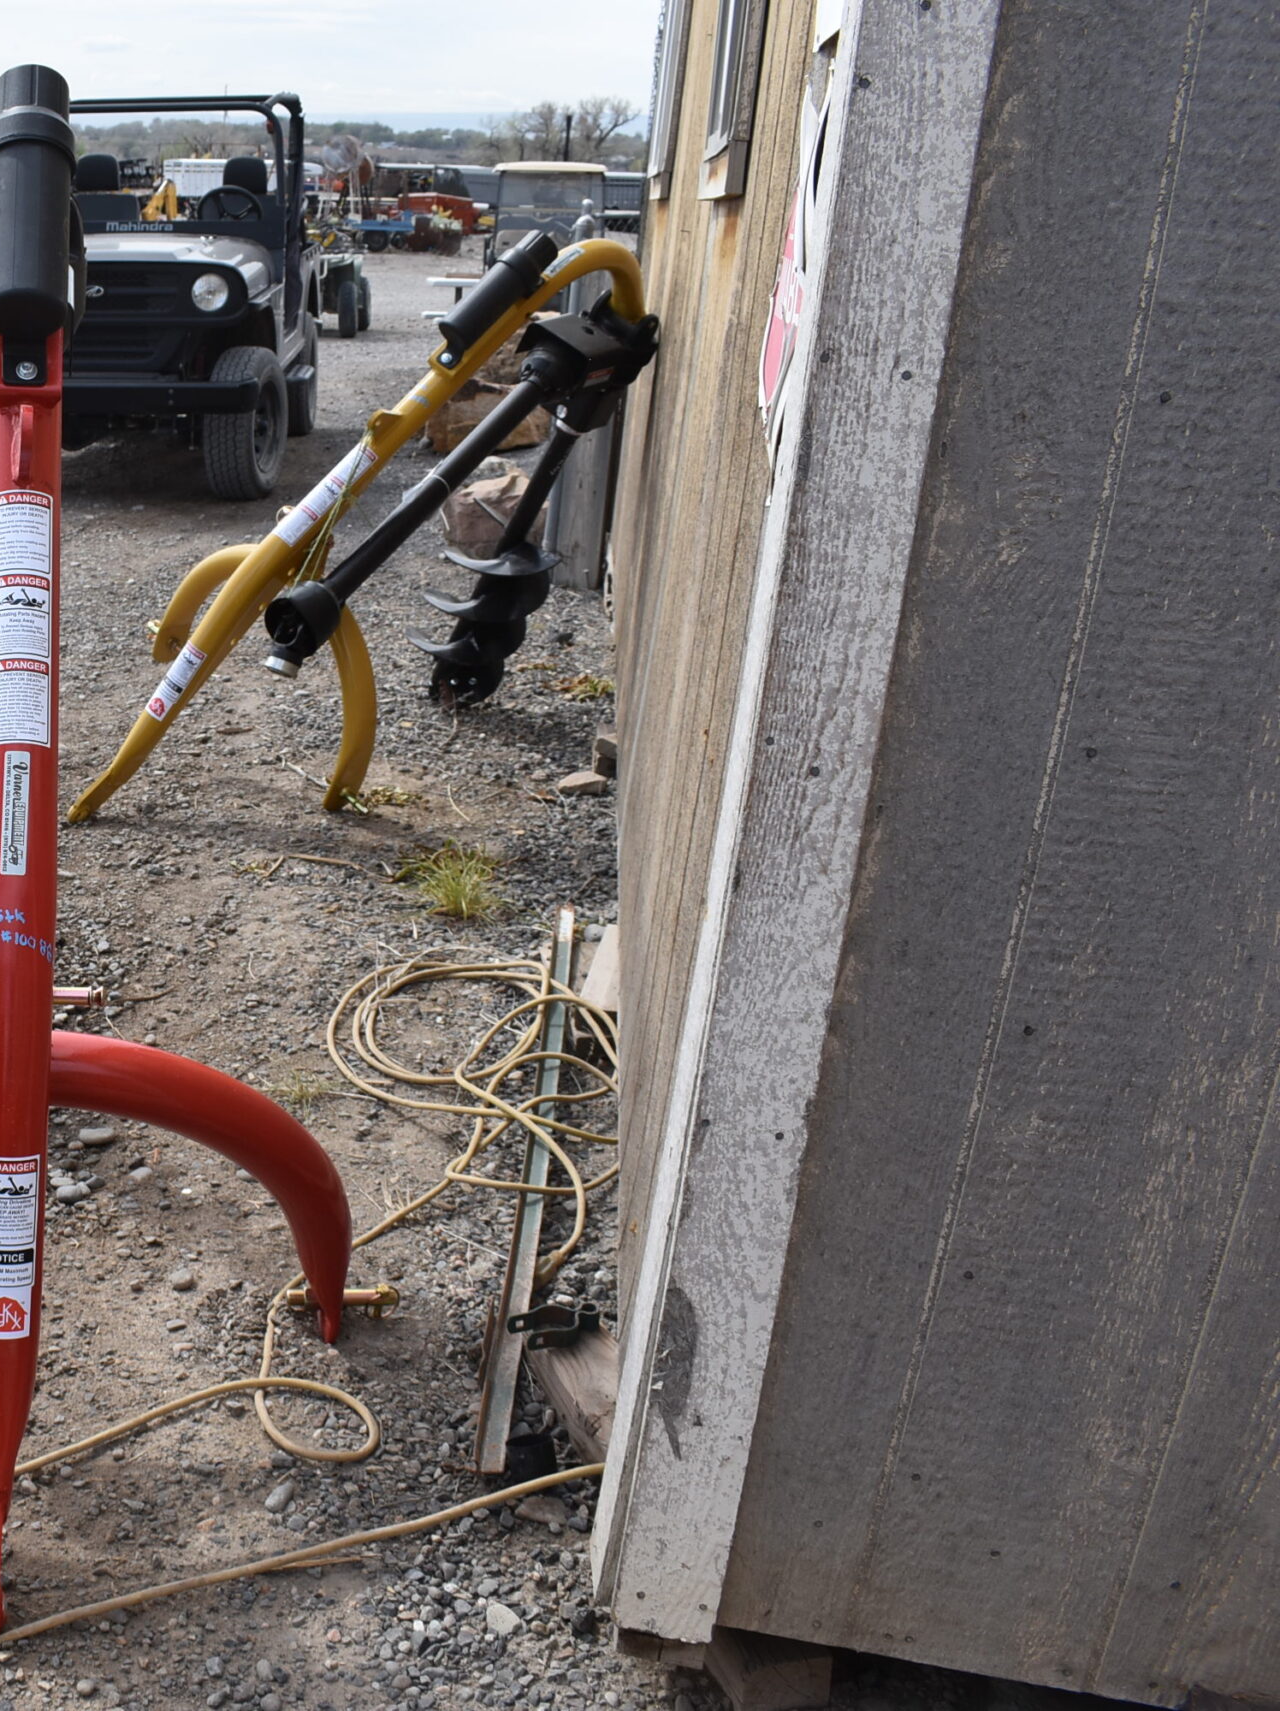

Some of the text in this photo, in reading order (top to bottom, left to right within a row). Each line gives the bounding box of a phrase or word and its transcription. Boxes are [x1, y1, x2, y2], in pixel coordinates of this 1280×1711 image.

[106, 221, 174, 232] Mahindra
[9, 494, 49, 507] DANGER
[7, 576, 48, 589] DANGER
[5, 660, 47, 673] DANGER
[12, 761, 29, 847] Varner EQUIPMENT
